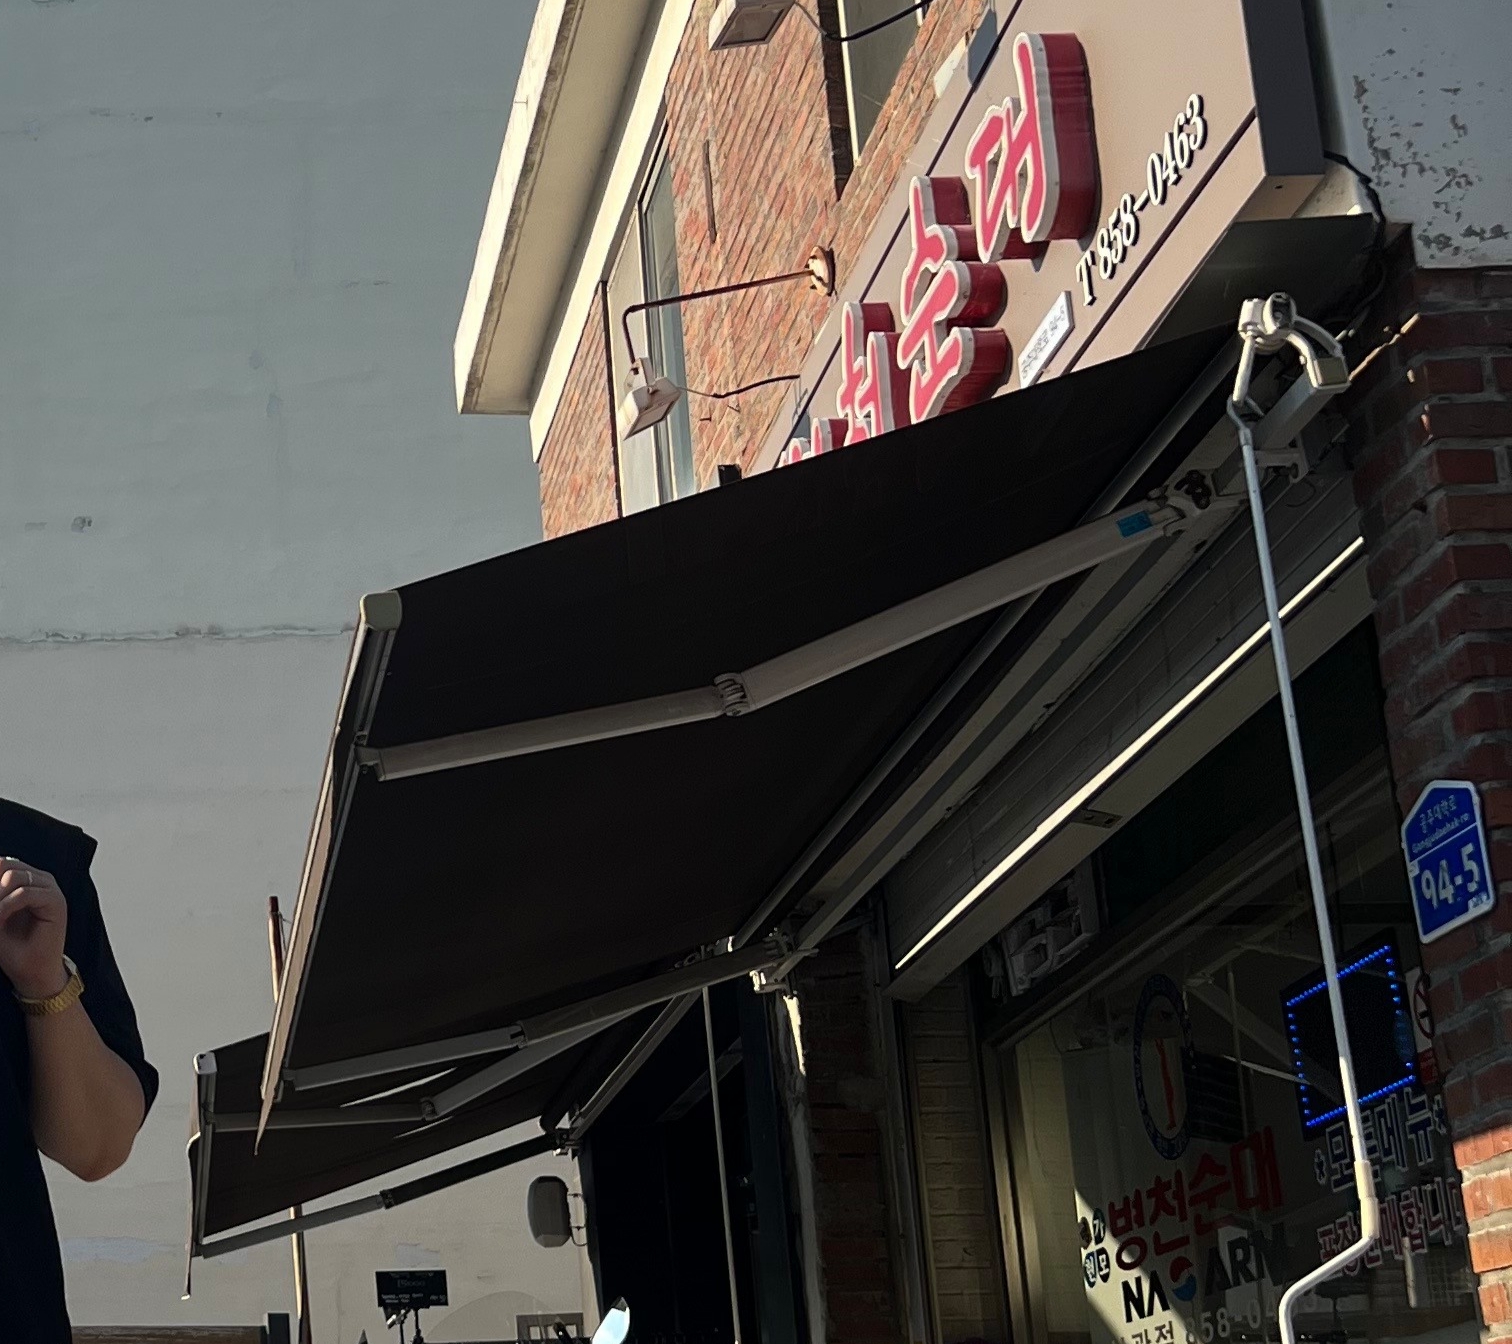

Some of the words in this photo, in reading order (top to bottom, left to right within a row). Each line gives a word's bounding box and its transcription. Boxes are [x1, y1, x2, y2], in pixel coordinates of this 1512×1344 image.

[1096, 93, 1206, 280] 858-0463
[1420, 842, 1481, 911] 94-5
[1107, 1125, 1285, 1271] 병천순대
